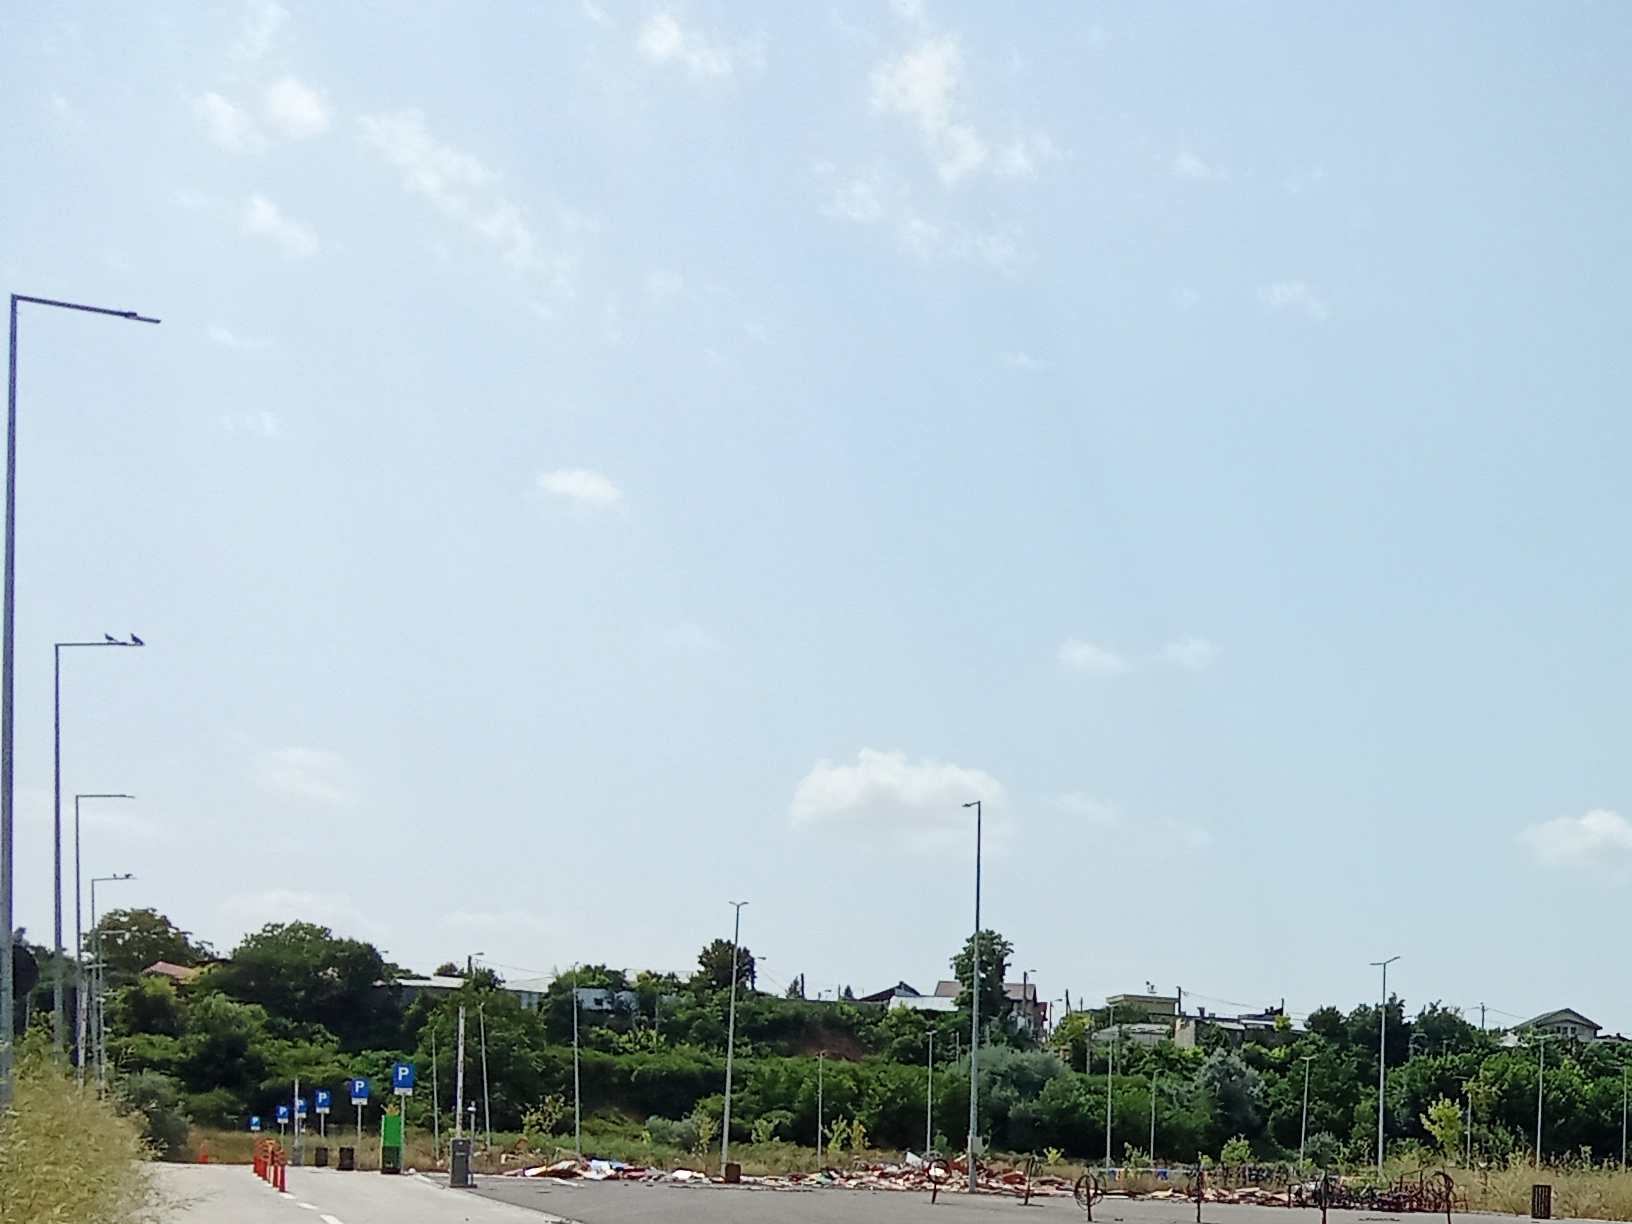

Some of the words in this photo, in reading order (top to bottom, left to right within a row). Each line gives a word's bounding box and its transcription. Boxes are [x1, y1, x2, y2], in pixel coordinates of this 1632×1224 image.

[398, 1066, 410, 1081] P
[355, 1080, 365, 1093] P
[318, 1092, 327, 1104] P
